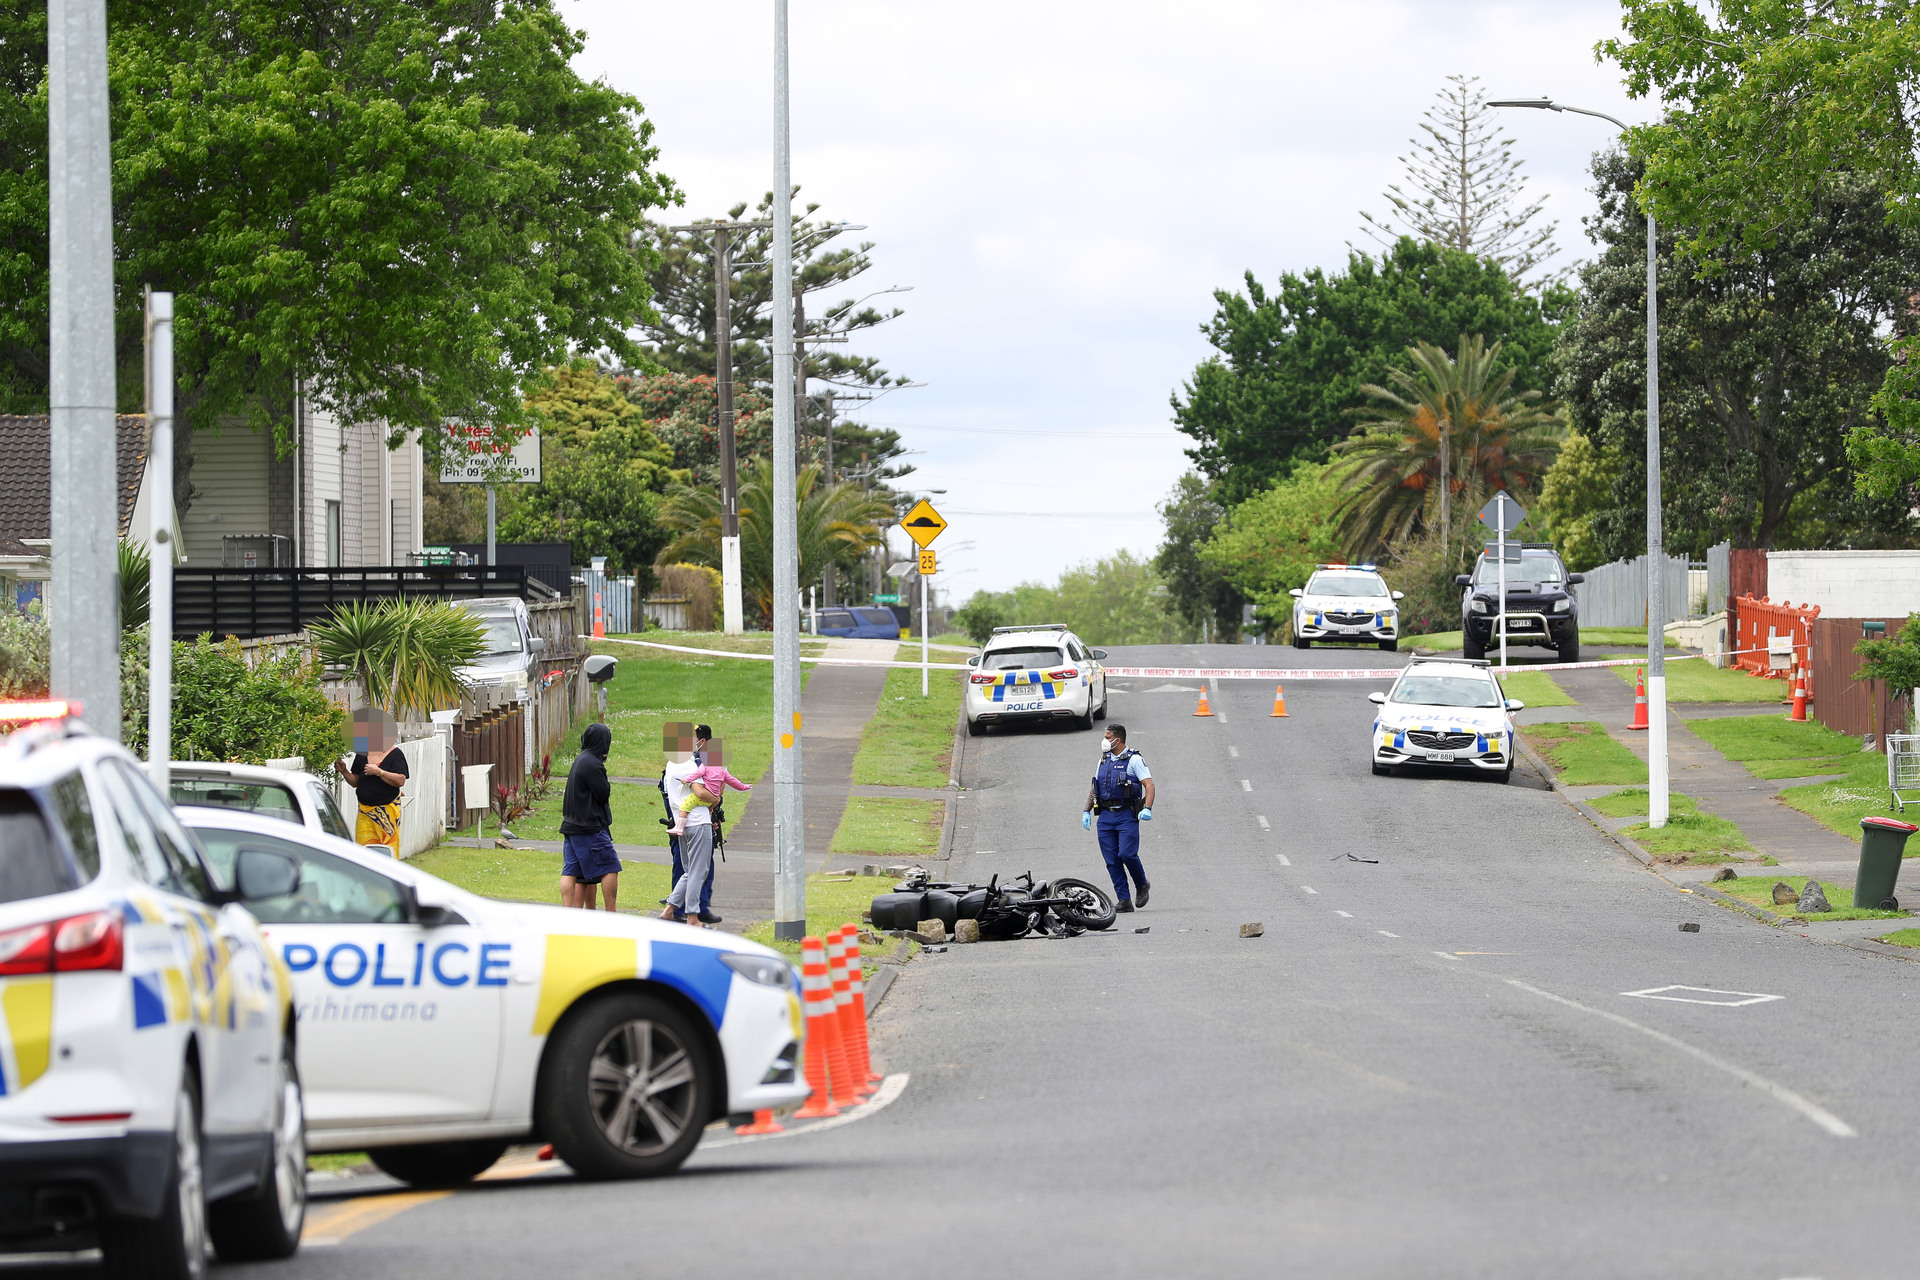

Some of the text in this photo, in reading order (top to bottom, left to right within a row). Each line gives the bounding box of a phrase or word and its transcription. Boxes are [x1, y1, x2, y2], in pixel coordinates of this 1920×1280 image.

[467, 467, 479, 477] 09
[921, 555, 934, 569] 25
[1143, 668, 1175, 676] EMERGENCY
[1200, 669, 1231, 677] EMERGENCY
[1256, 670, 1287, 678] EMERGENCY
[1312, 670, 1344, 678] EMERGENCY
[1006, 702, 1043, 711] POLICE
[1399, 715, 1487, 727] POLICE
[283, 943, 511, 986] POLICE
[296, 993, 438, 1021] rihimana
